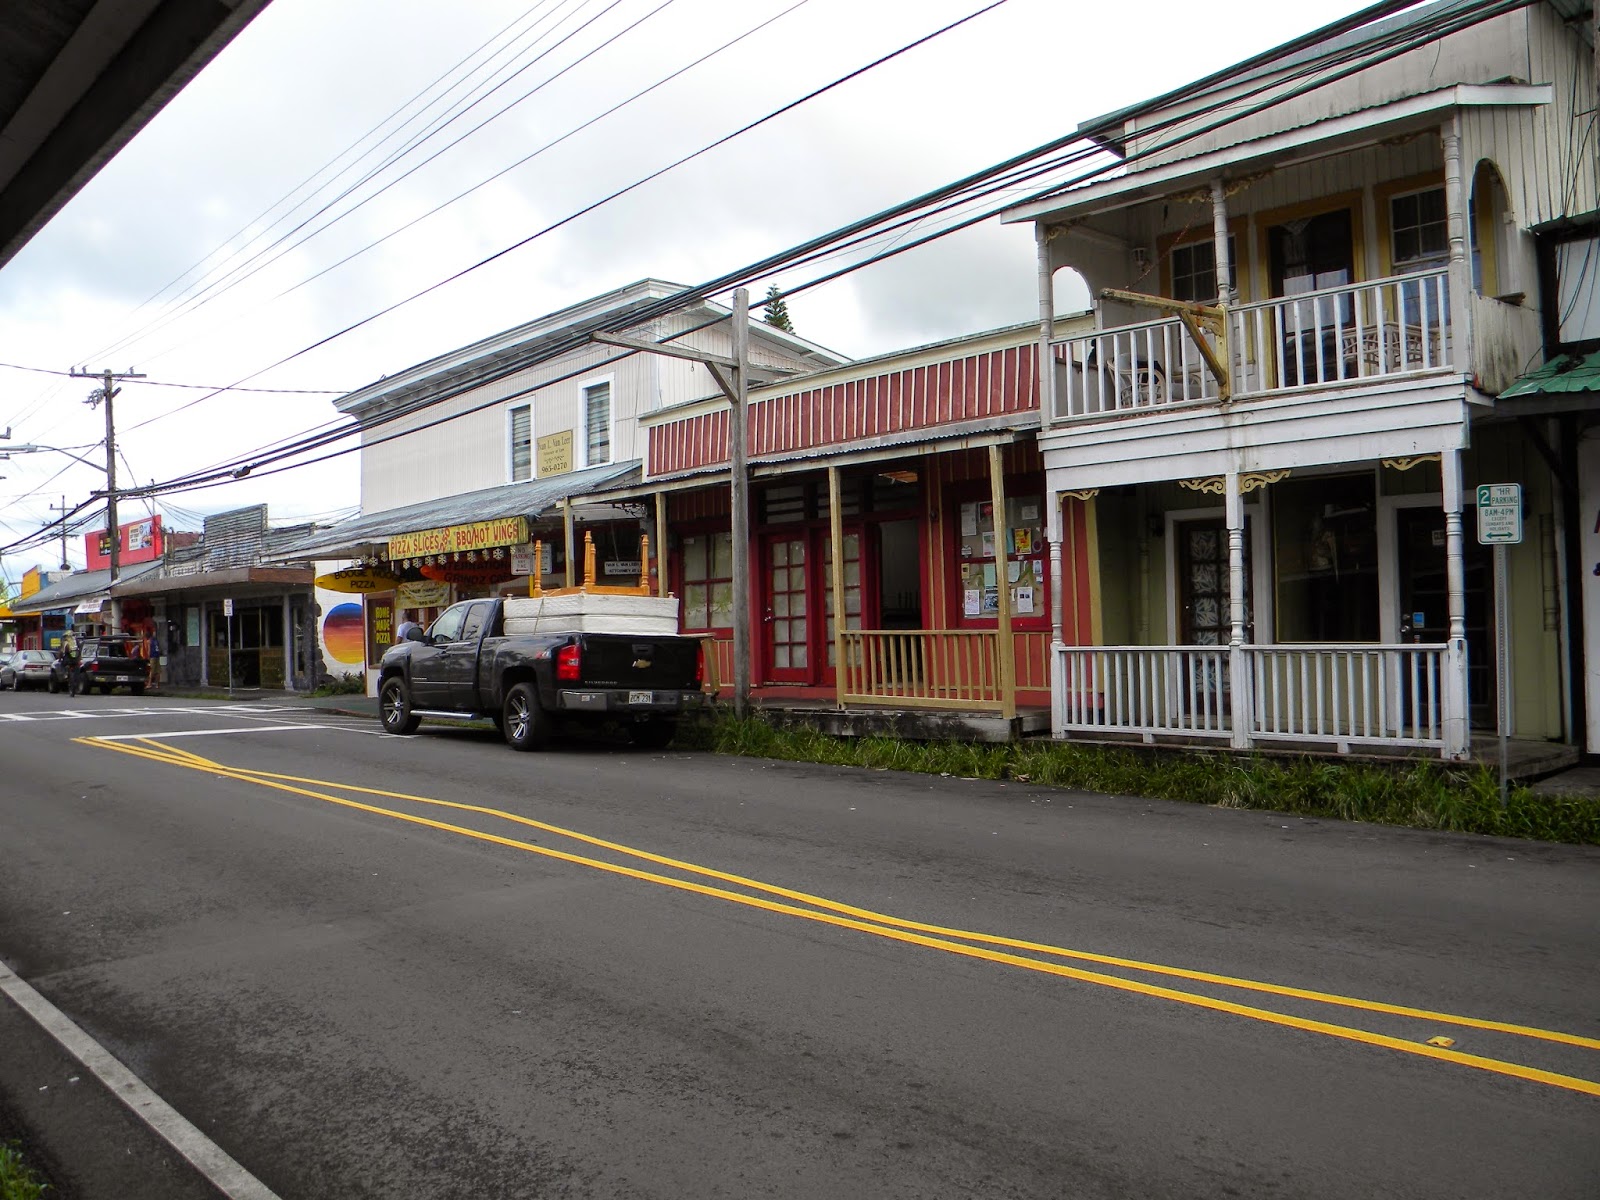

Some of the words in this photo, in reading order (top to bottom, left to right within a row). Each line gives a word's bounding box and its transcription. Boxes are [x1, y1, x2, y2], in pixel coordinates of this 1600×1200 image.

[541, 462, 567, 473] 965-0270
[1480, 490, 1489, 504] 2
[1491, 496, 1517, 504] PARKING
[391, 541, 410, 554] PIZZA
[414, 535, 439, 553] SLICES
[494, 522, 518, 540] WINGS
[351, 581, 376, 590] PIZZA
[375, 607, 390, 618] HOME
[376, 619, 390, 631] MADE
[376, 632, 391, 644] PIZZA
